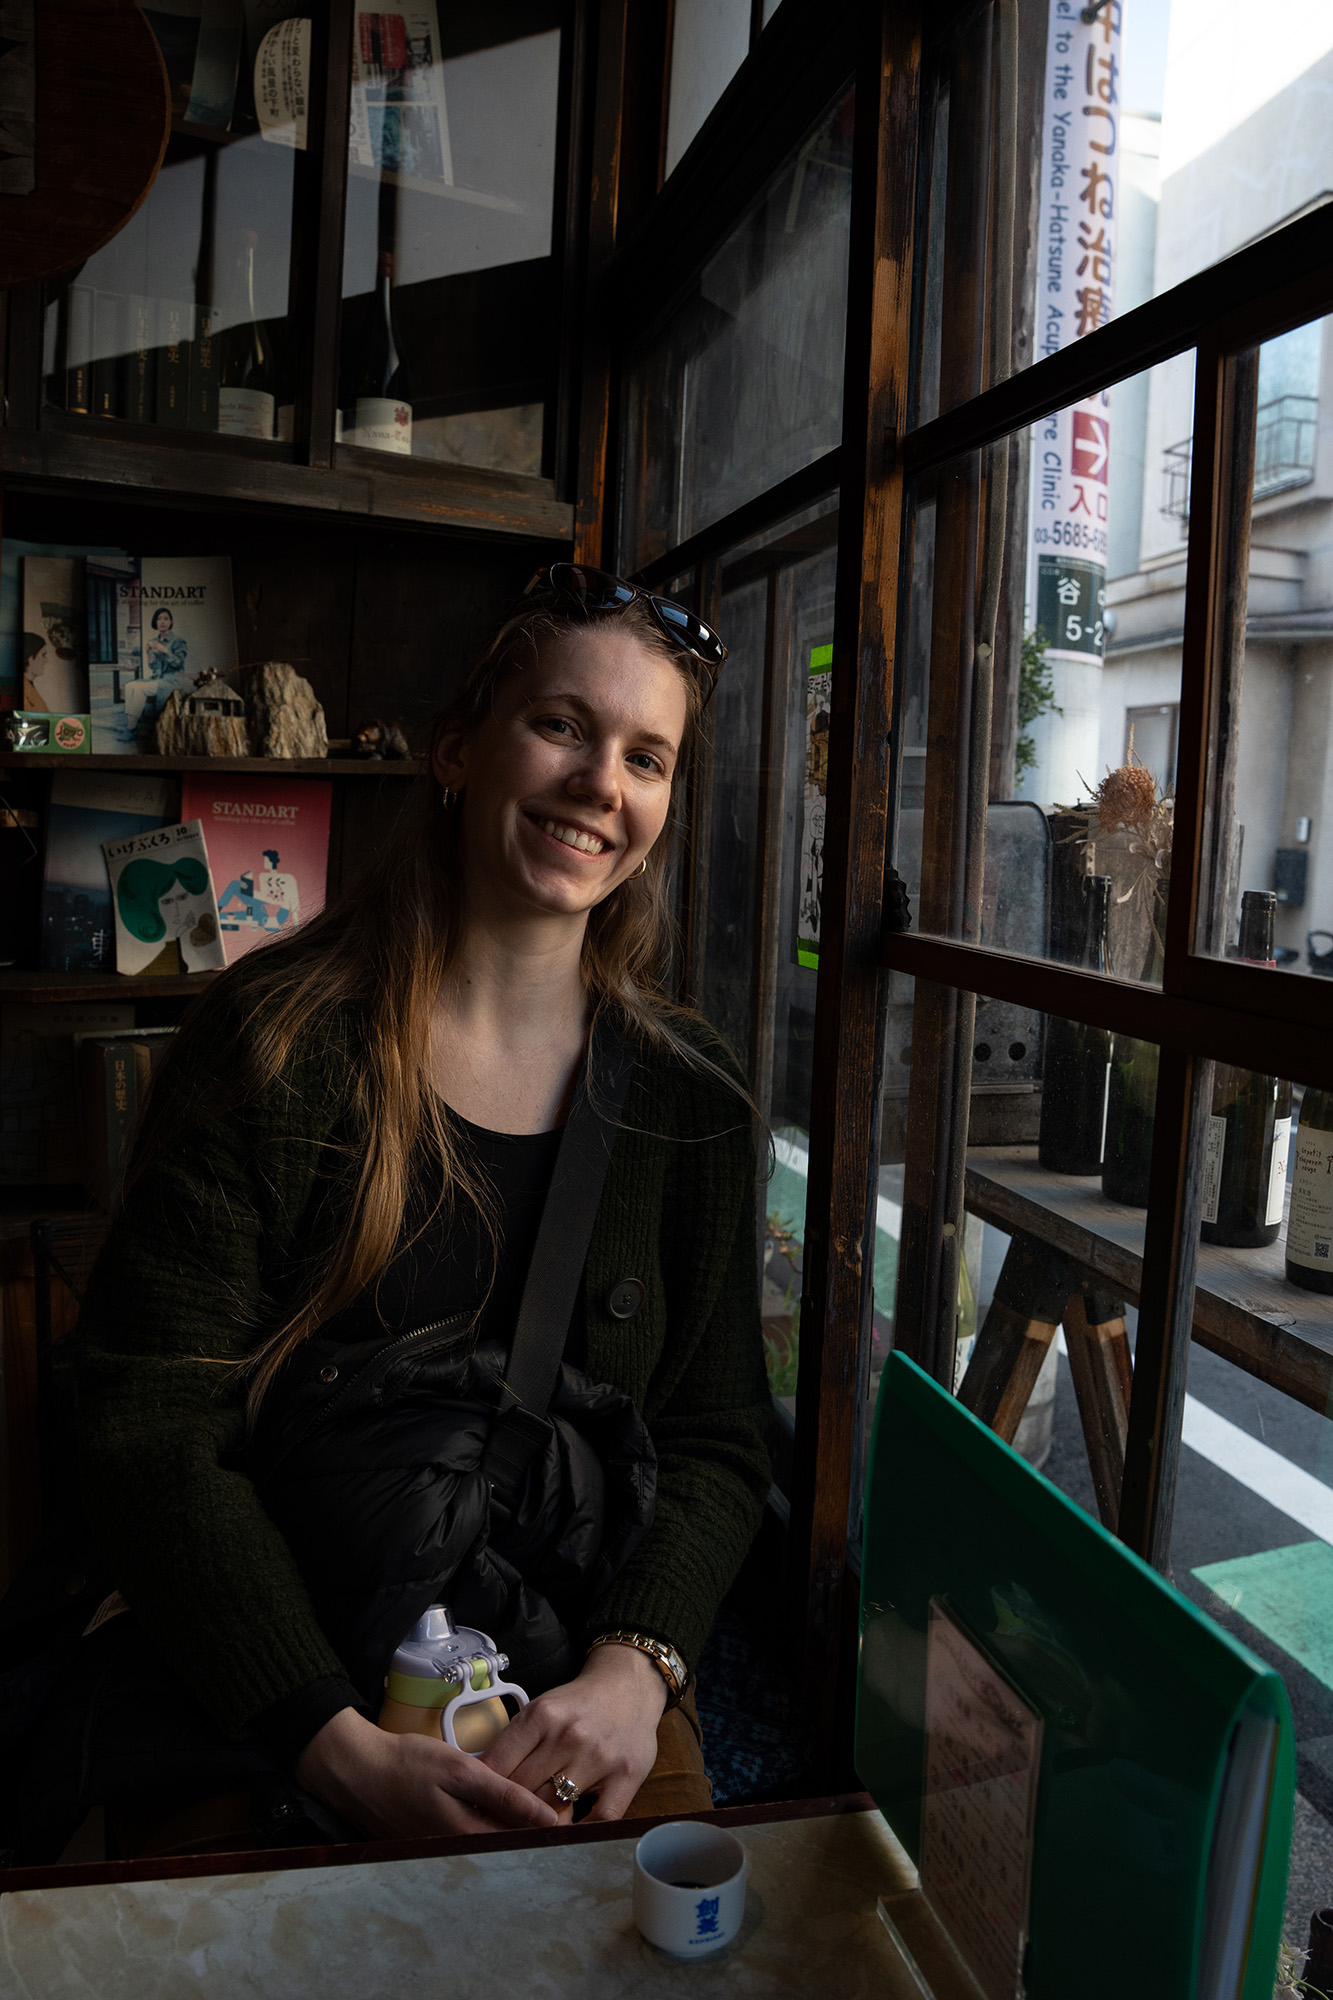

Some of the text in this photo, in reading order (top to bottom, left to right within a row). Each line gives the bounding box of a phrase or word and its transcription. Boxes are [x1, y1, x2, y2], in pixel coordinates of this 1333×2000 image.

[1055, 32, 1073, 53] to
[1053, 64, 1074, 100] the
[1048, 111, 1072, 293] Yanaka-Hatsune
[1041, 450, 1063, 510] Clinic
[1069, 484, 1107, 521] 入口
[120, 586, 206, 598] STANDART
[212, 801, 299, 819] STANDART
[176, 827, 187, 836] 10
